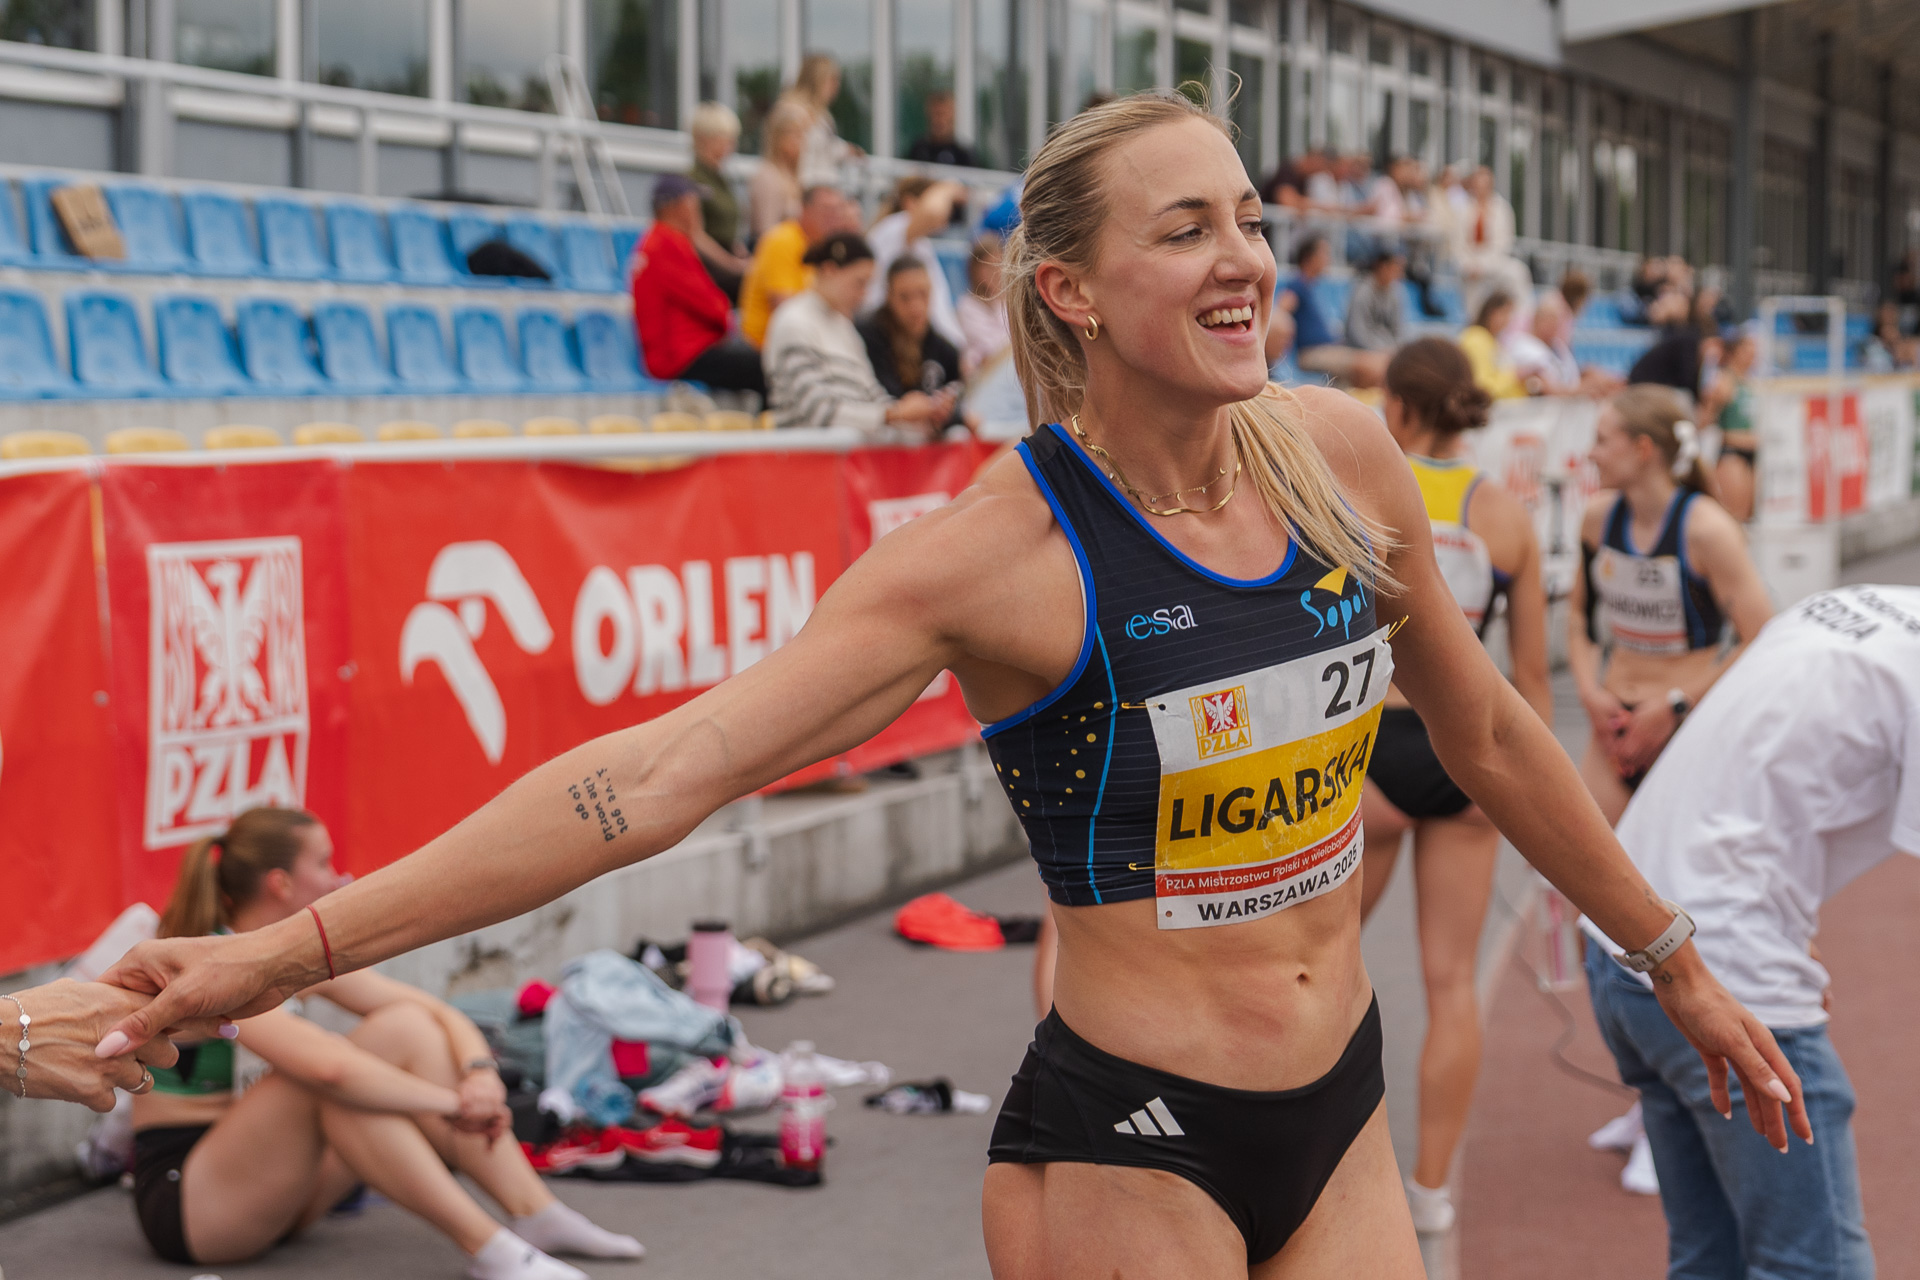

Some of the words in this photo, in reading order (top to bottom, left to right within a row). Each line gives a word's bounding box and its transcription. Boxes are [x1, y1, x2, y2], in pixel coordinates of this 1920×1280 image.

[571, 551, 817, 706] ORLEN
[1321, 647, 1376, 719] 27
[1200, 732, 1249, 756] PZLA
[158, 733, 300, 827] PZLA
[568, 784, 581, 800] to
[575, 803, 589, 820] go
[583, 777, 598, 800] the
[595, 801, 616, 842] world
[1169, 731, 1372, 842] LIGARSKA
[611, 808, 629, 834] got
[1166, 878, 1195, 890] PZLA
[1199, 870, 1270, 888] Mistrzostwa
[1273, 861, 1301, 876] Polski
[1302, 856, 1311, 865] w
[1198, 870, 1330, 921] WARSZAWA
[1334, 843, 1357, 880] 2025
